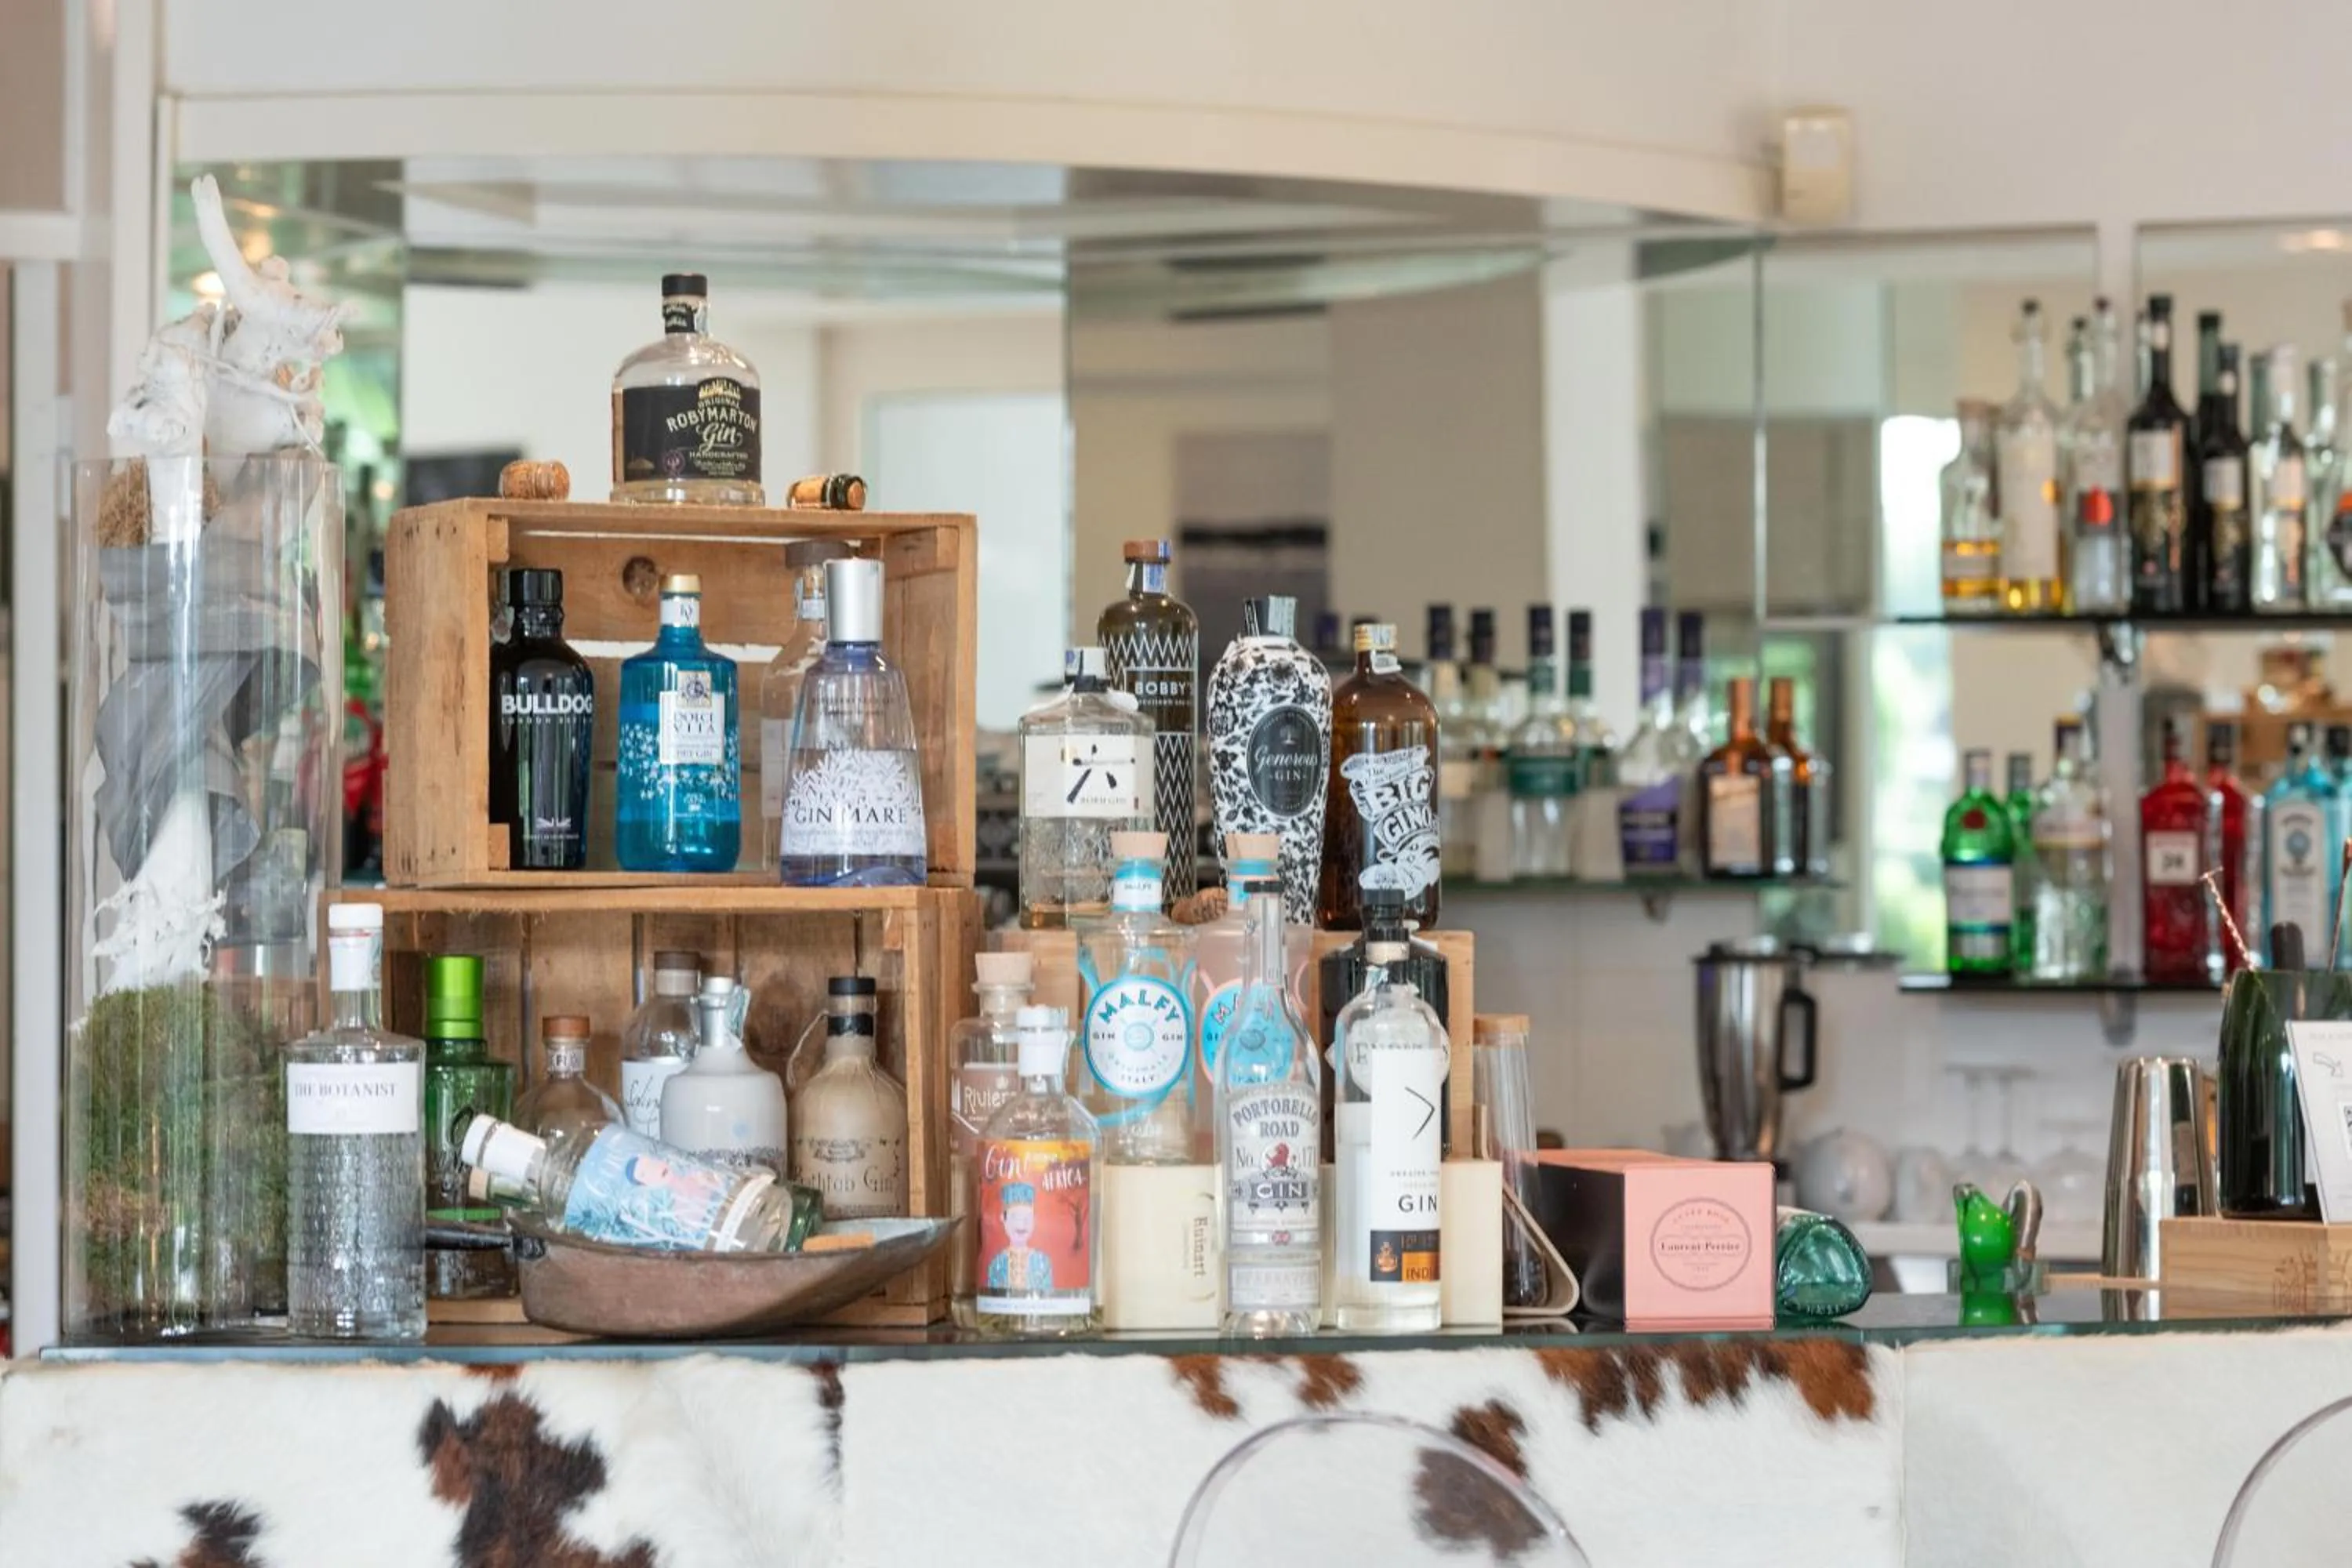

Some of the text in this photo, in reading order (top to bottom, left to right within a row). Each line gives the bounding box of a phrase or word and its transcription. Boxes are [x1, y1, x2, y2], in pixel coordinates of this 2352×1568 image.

[666, 406, 757, 434] ROBYMARTON
[696, 423, 742, 452] Gin
[501, 693, 593, 715] BULLDOG
[1254, 745, 1318, 773] Generous
[1274, 769, 1301, 781] GIN
[1364, 768, 1433, 813] BIG
[795, 806, 907, 824] GIN MARE
[1098, 989, 1181, 1025] MALFY
[1092, 1032, 1184, 1042] GIN GIN
[318, 1082, 398, 1098] BOTANIST
[963, 1083, 1018, 1116] Rivier
[1232, 1098, 1319, 1127] PORTOBELLO
[1259, 1121, 1300, 1138] ROAD
[1256, 1181, 1303, 1200] GIN
[1398, 1193, 1438, 1214] GIN
